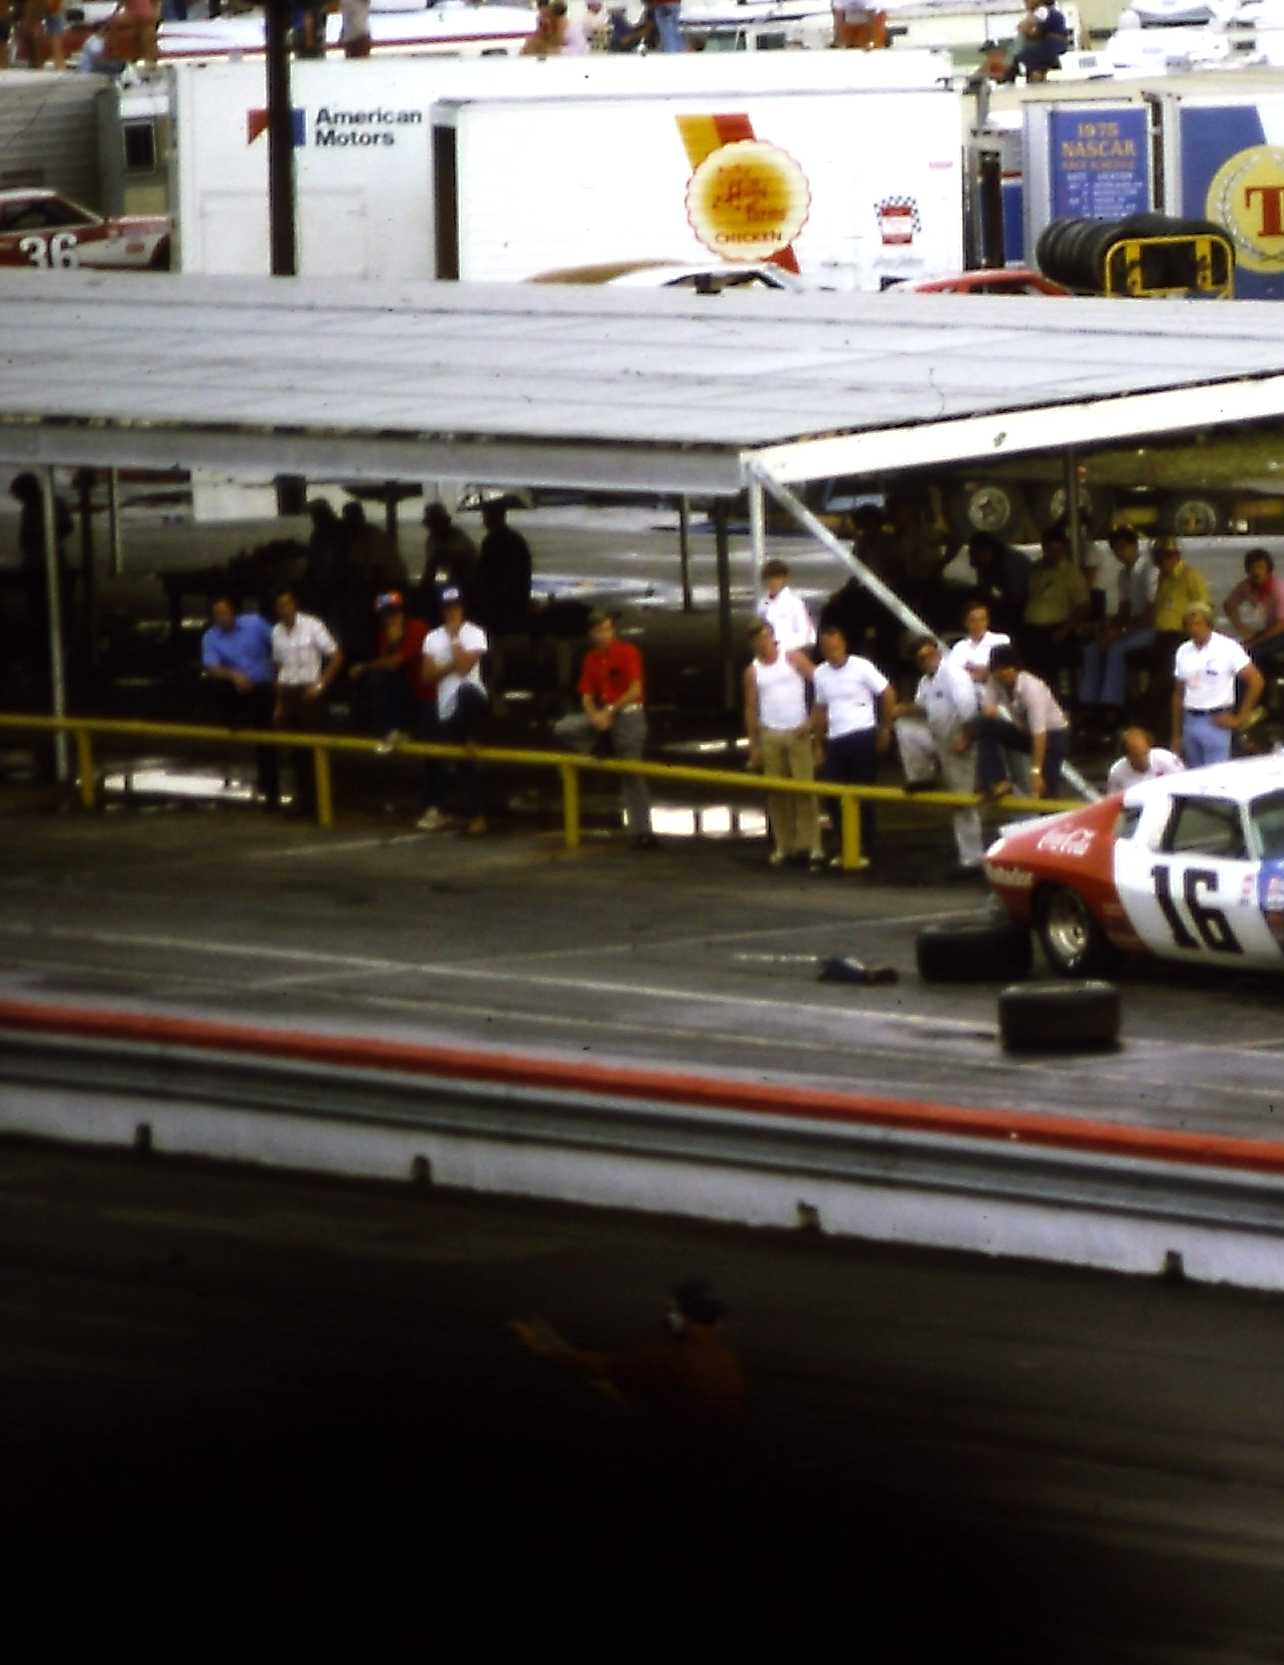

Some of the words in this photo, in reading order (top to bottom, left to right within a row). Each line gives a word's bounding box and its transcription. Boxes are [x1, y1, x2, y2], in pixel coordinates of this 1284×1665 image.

[315, 107, 422, 124] American
[315, 129, 395, 146] Motors
[1061, 140, 1137, 156] NASCAR
[19, 233, 79, 268] 36
[1151, 865, 1245, 954] 16
